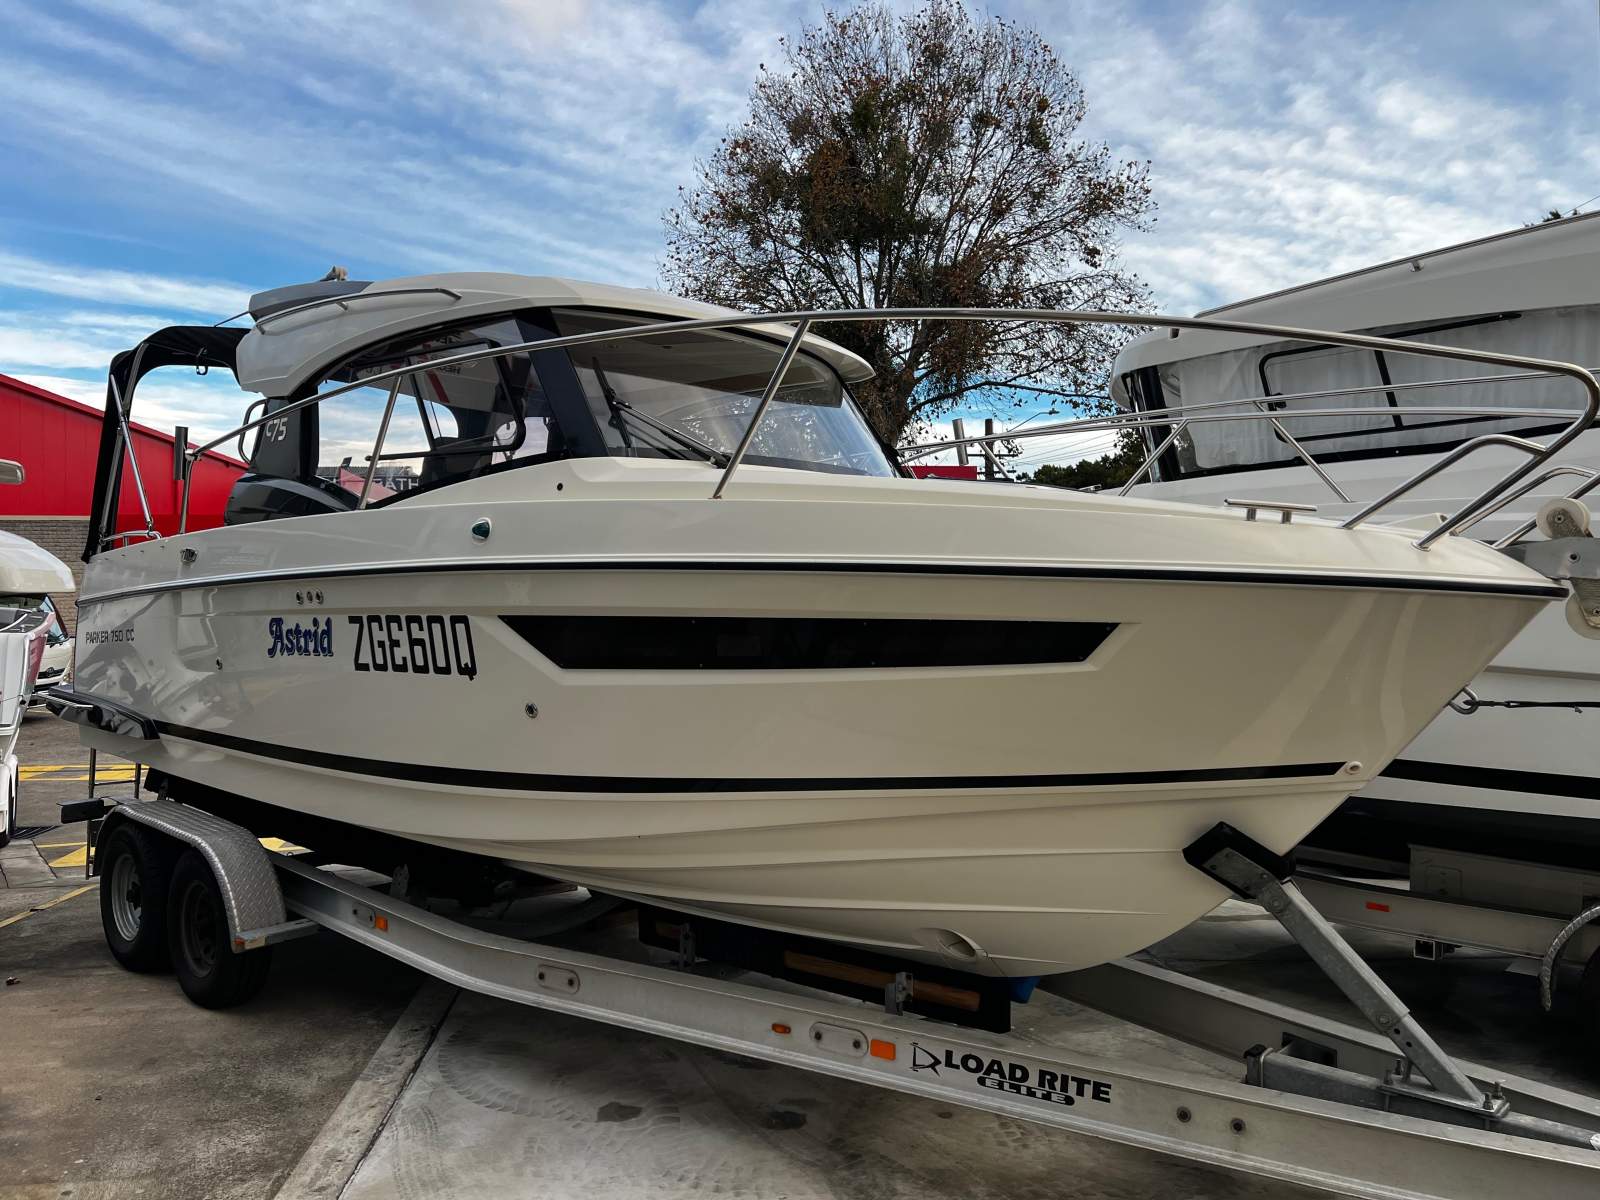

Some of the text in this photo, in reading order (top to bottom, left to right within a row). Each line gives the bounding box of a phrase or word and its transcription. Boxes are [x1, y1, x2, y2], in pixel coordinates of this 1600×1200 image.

[265, 417, 289, 442] C75
[86, 629, 134, 644] PARKER 750 CC
[267, 615, 477, 681] Astrid ZGE60Q
[944, 1050, 1112, 1103] LOAD RITE
[984, 1077, 1067, 1105] ELITE
